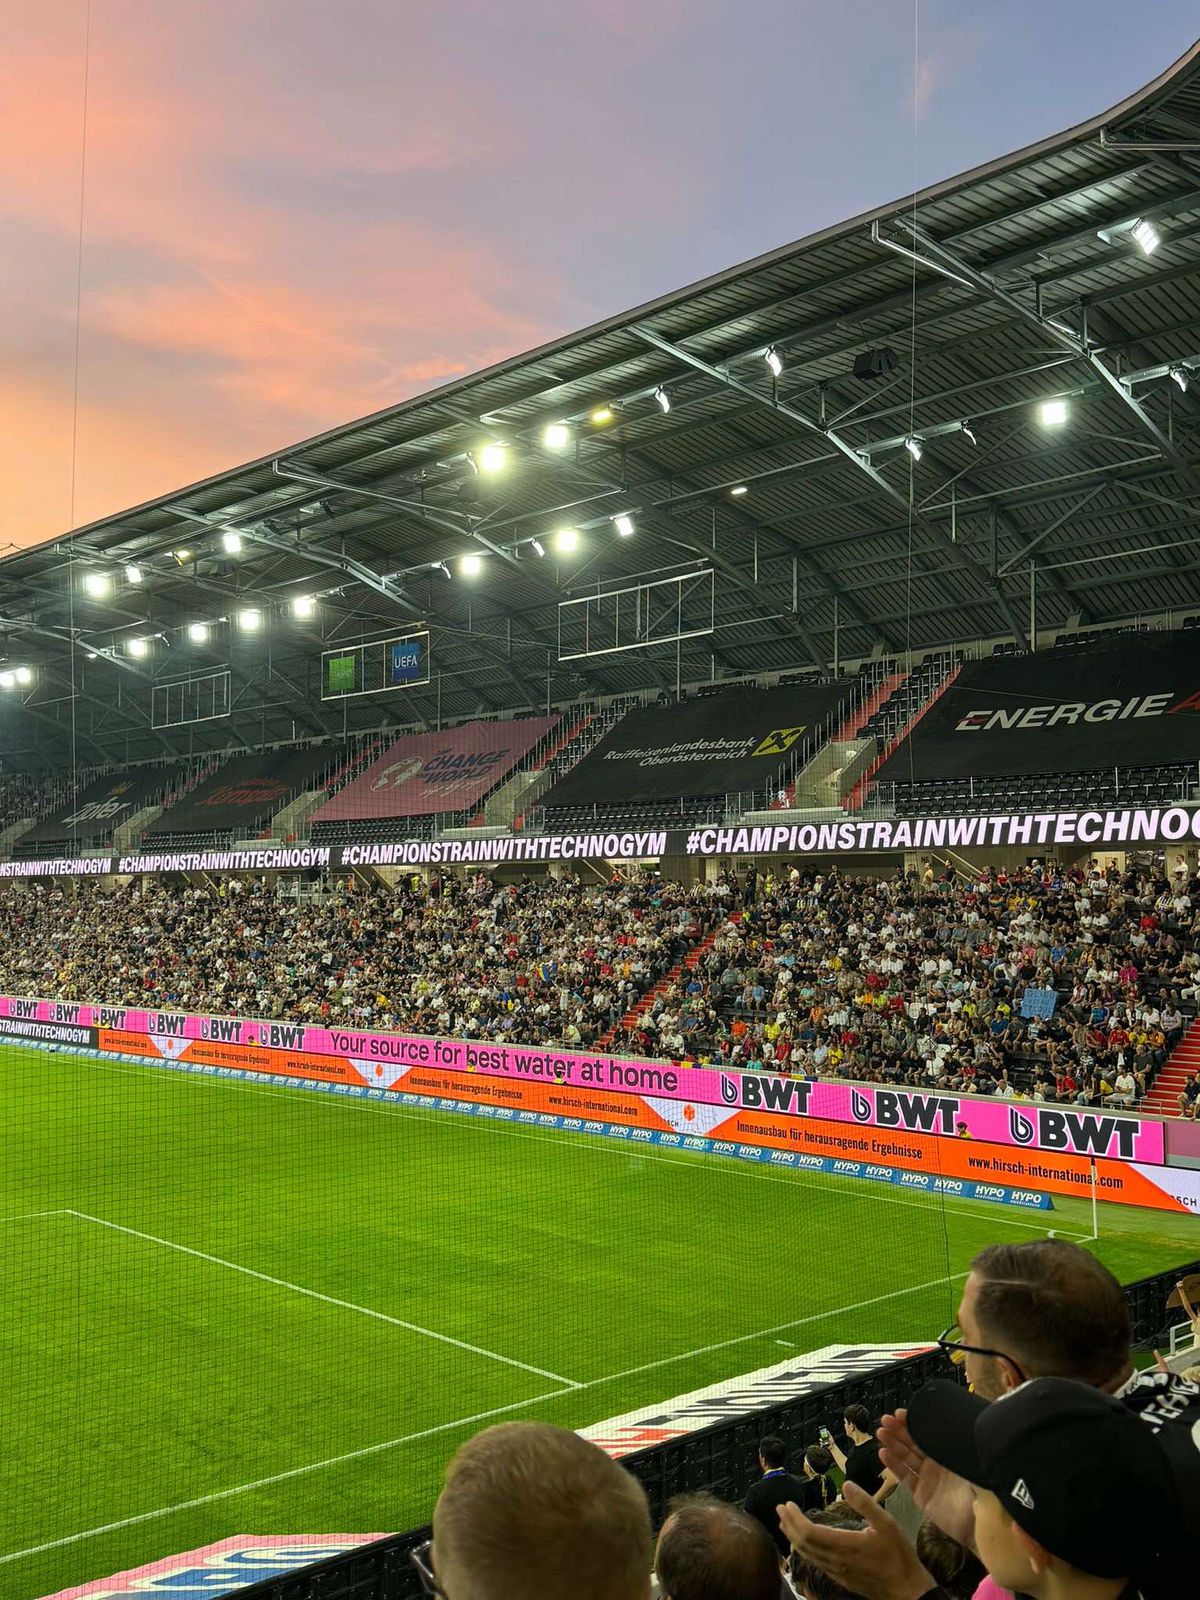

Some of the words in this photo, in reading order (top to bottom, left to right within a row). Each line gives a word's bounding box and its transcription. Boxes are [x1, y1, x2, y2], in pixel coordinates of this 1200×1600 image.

[394, 654, 418, 669] UEFA
[955, 692, 1175, 731] ENERGIE
[604, 736, 757, 760] Raiffeisenlandesbank
[422, 750, 508, 772] CHANGE
[639, 749, 747, 767] Oberösterreich
[425, 765, 493, 784] WORLD
[686, 807, 1200, 854] #CHAMPIONSTRAINWITHTECHNO
[341, 832, 667, 865] #CHAMPIONSTRAINWITHTECHNOGYM
[119, 848, 330, 873] #CHAMPIONSTRAINWITHTECHNOGYM
[16, 1001, 38, 1018] BWT
[56, 1004, 80, 1023] BWT
[100, 1009, 126, 1029] BWT
[157, 1014, 185, 1035] BWT
[211, 1020, 242, 1041] BWT
[271, 1026, 305, 1049] BWT
[331, 1032, 366, 1053] Your
[370, 1039, 429, 1061] source
[434, 1041, 462, 1065] for
[466, 1045, 511, 1072] best
[514, 1053, 575, 1079] water
[581, 1060, 604, 1083] at
[610, 1060, 678, 1092] home
[742, 1075, 812, 1114] BWT
[549, 1096, 638, 1116] www.hirsch-international.com
[876, 1091, 959, 1133] BWT
[519, 1111, 537, 1121] HYPO
[539, 1114, 557, 1124] HYPO
[563, 1118, 582, 1127] HYPO
[584, 1121, 604, 1131] HYPO
[610, 1125, 629, 1135] HYPO
[632, 1128, 652, 1139] HYPO
[1038, 1110, 1139, 1158] BWT
[660, 1133, 680, 1144] HYPO
[684, 1137, 705, 1147] HYPO
[713, 1141, 735, 1152] HYPO
[737, 1120, 787, 1139] Innenausbau
[789, 1129, 803, 1141] für
[804, 1131, 869, 1151] herausragende
[872, 1140, 922, 1159] Ergebnisse
[739, 1145, 761, 1157] HYPO
[771, 1151, 795, 1162] HYPO
[800, 1156, 823, 1167] HYPO
[833, 1161, 860, 1172] HYPO
[865, 1166, 893, 1177] HYPO
[901, 1173, 929, 1185] HYPO
[934, 1179, 963, 1191] HYPO
[975, 1185, 1005, 1197] HYPO
[1011, 1191, 1042, 1203] HYPO
